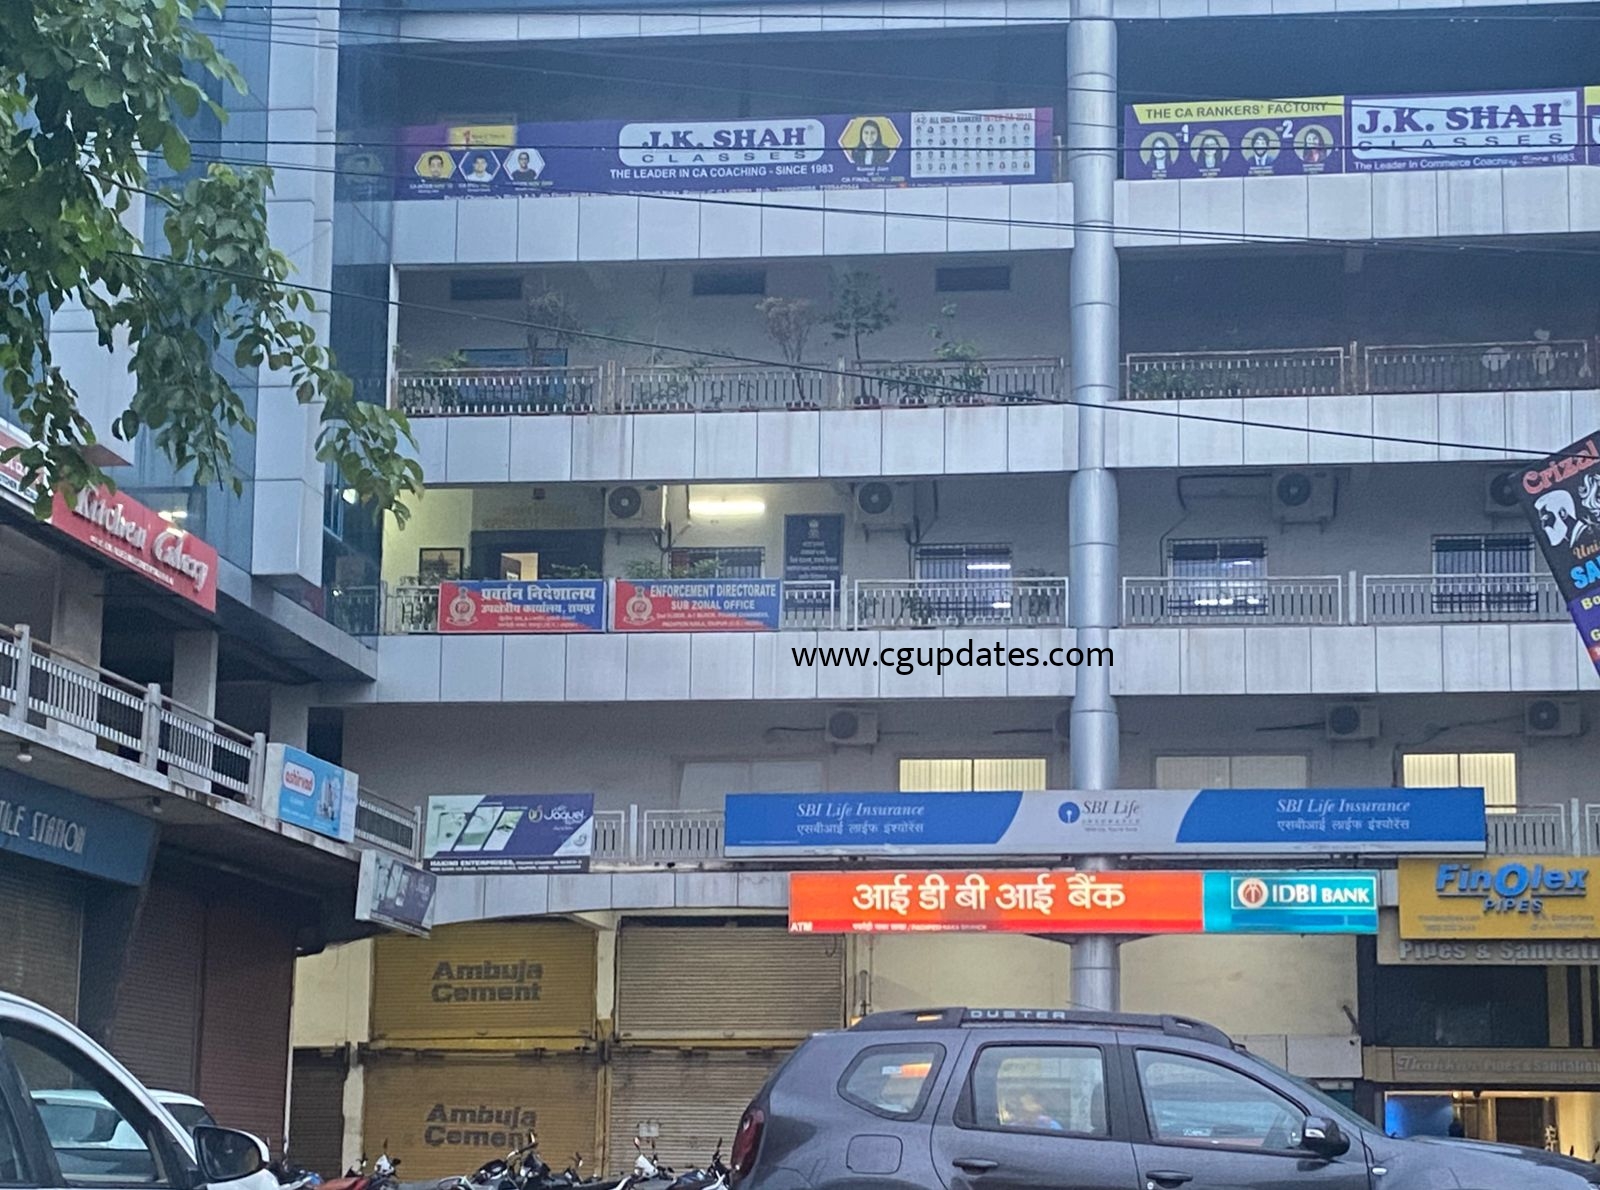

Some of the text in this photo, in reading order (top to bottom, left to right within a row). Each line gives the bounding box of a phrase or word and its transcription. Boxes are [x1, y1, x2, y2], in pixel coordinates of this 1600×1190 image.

[1145, 101, 1329, 120] THE CA RANKERS' FACTORY
[1357, 103, 1562, 133] J.K. SHAH
[642, 127, 806, 149] J.K. SHAH
[1282, 120, 1294, 138] 2
[1357, 134, 1562, 152] CLASSES
[642, 151, 806, 164] CLASSES
[1355, 162, 1373, 170] The
[1374, 160, 1406, 170] Leader
[1409, 160, 1418, 168] In
[1420, 158, 1471, 169] Commerce
[610, 168, 631, 179] THE
[633, 168, 677, 178] LEADER
[679, 167, 690, 178] IN
[692, 167, 709, 178] CA
[710, 166, 766, 178] COACHING
[776, 165, 808, 176] SINCE
[812, 164, 834, 174] 1983
[74, 480, 148, 550] Kitchen
[1570, 555, 1600, 589] SA
[481, 584, 596, 601] प्रवर्तन निदेशालय
[650, 583, 776, 598] ENFORCEMENT DIRECTORATE
[671, 600, 755, 610] SUB ZONAL OFFICE
[796, 802, 925, 820] SBI Life Insurance
[1082, 800, 1140, 818] SBI Life
[1276, 798, 1410, 816] SBI Life Insurance
[28, 810, 87, 855] STATION
[852, 874, 1126, 914] आई डी बी आई बैंक
[1272, 884, 1370, 904] IDBI BANK
[1483, 898, 1544, 914] PIPES
[790, 922, 813, 932] ATM
[1400, 941, 1467, 961] Pipes
[1476, 943, 1492, 960] &
[432, 960, 544, 982] Ambuja
[432, 982, 542, 1002] Cement
[970, 1010, 1066, 1020] DUSTER
[426, 1104, 536, 1130] Ambuja
[424, 1126, 534, 1149] Cemen
